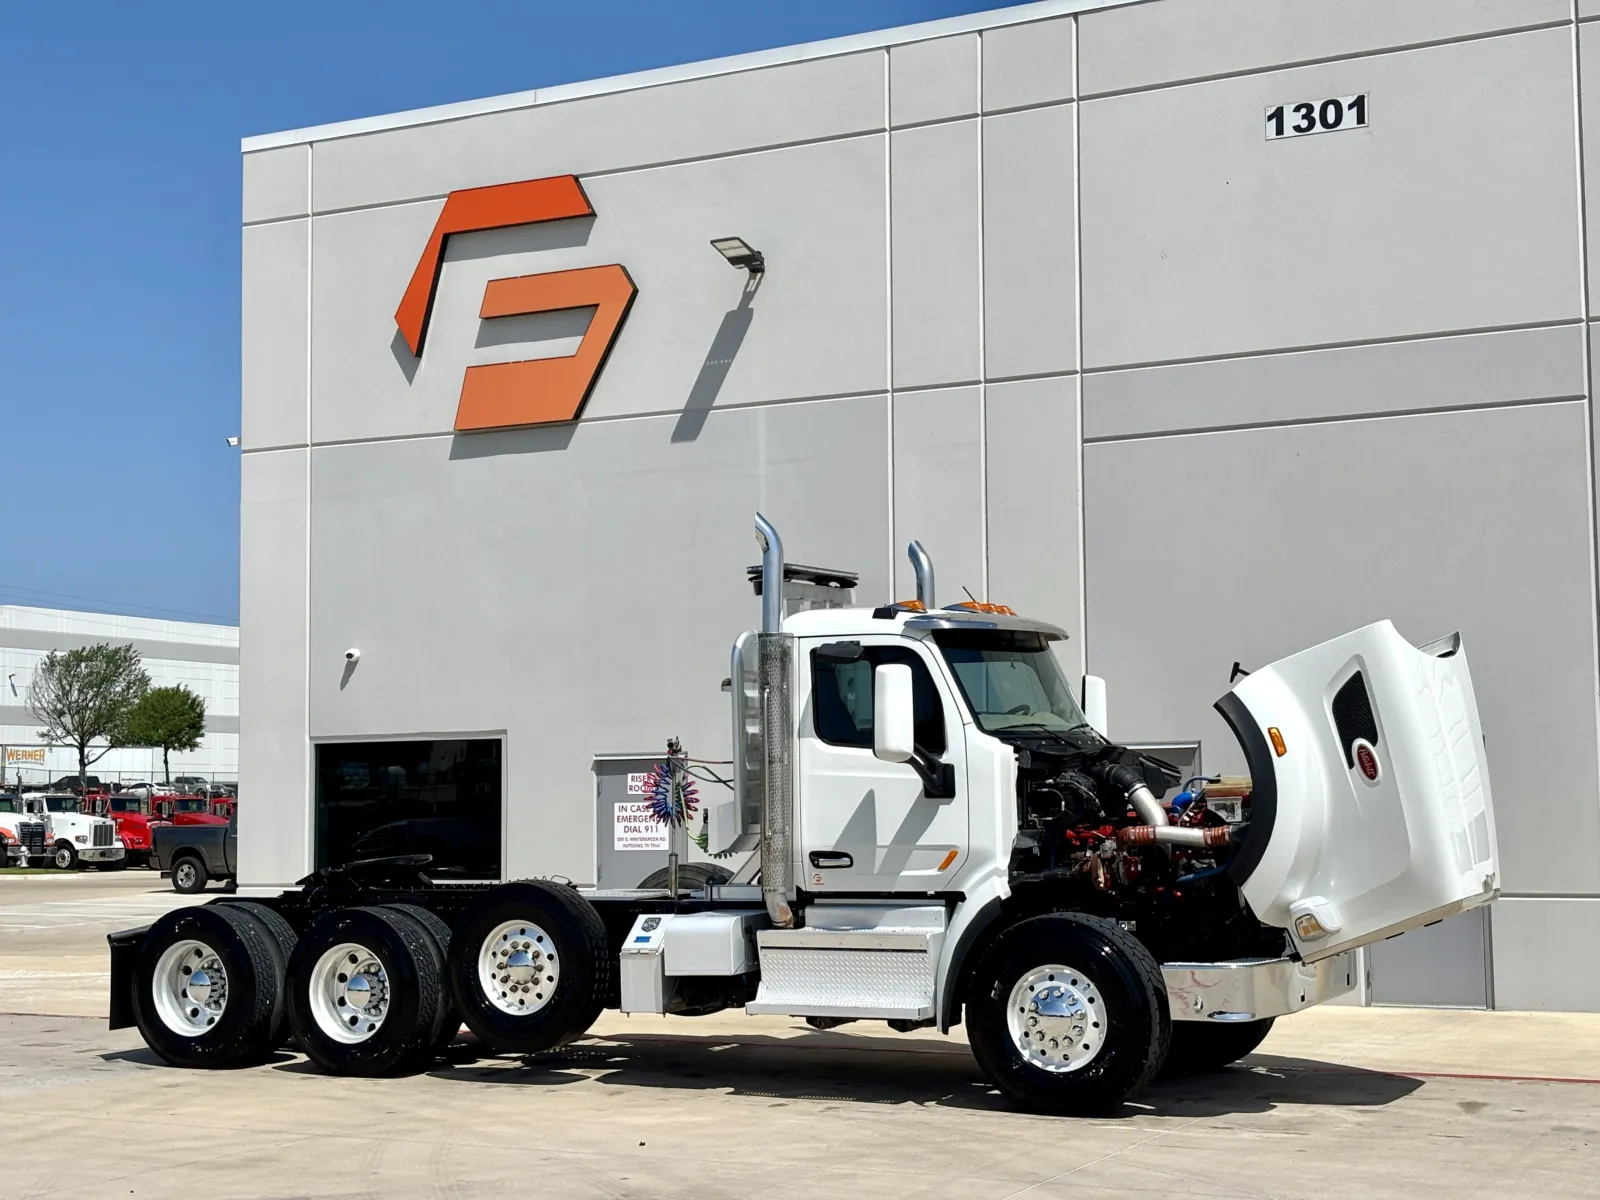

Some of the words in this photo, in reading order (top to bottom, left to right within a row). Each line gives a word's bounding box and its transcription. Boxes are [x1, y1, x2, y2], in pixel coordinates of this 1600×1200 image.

[1267, 94, 1366, 136] 1301
[6, 748, 45, 762] WERNER
[618, 805, 628, 813] IN
[630, 804, 651, 813] CASE
[616, 815, 664, 823] EMERGEN
[623, 825, 642, 833] DIAL
[644, 825, 658, 833] 911
